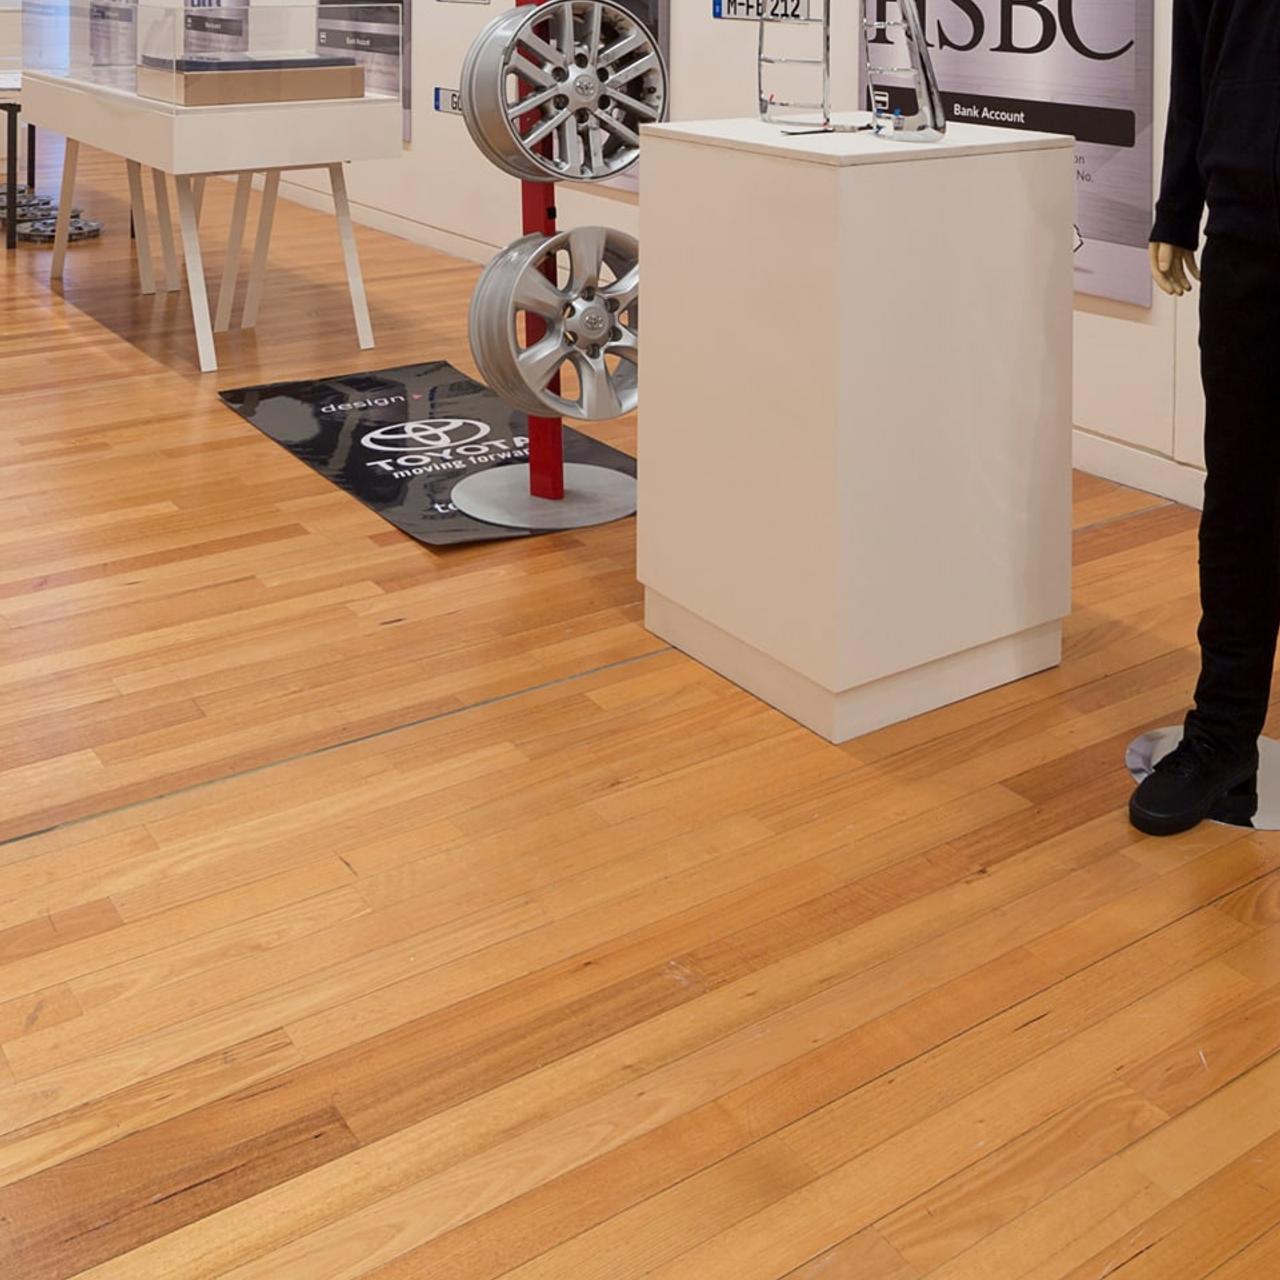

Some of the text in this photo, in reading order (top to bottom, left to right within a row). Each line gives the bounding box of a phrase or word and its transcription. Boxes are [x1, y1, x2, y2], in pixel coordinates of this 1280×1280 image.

[953, 103, 1025, 123] Bank Account
[320, 395, 405, 414] design
[365, 436, 530, 471] TOYOTA
[392, 447, 530, 479] moving forwar
